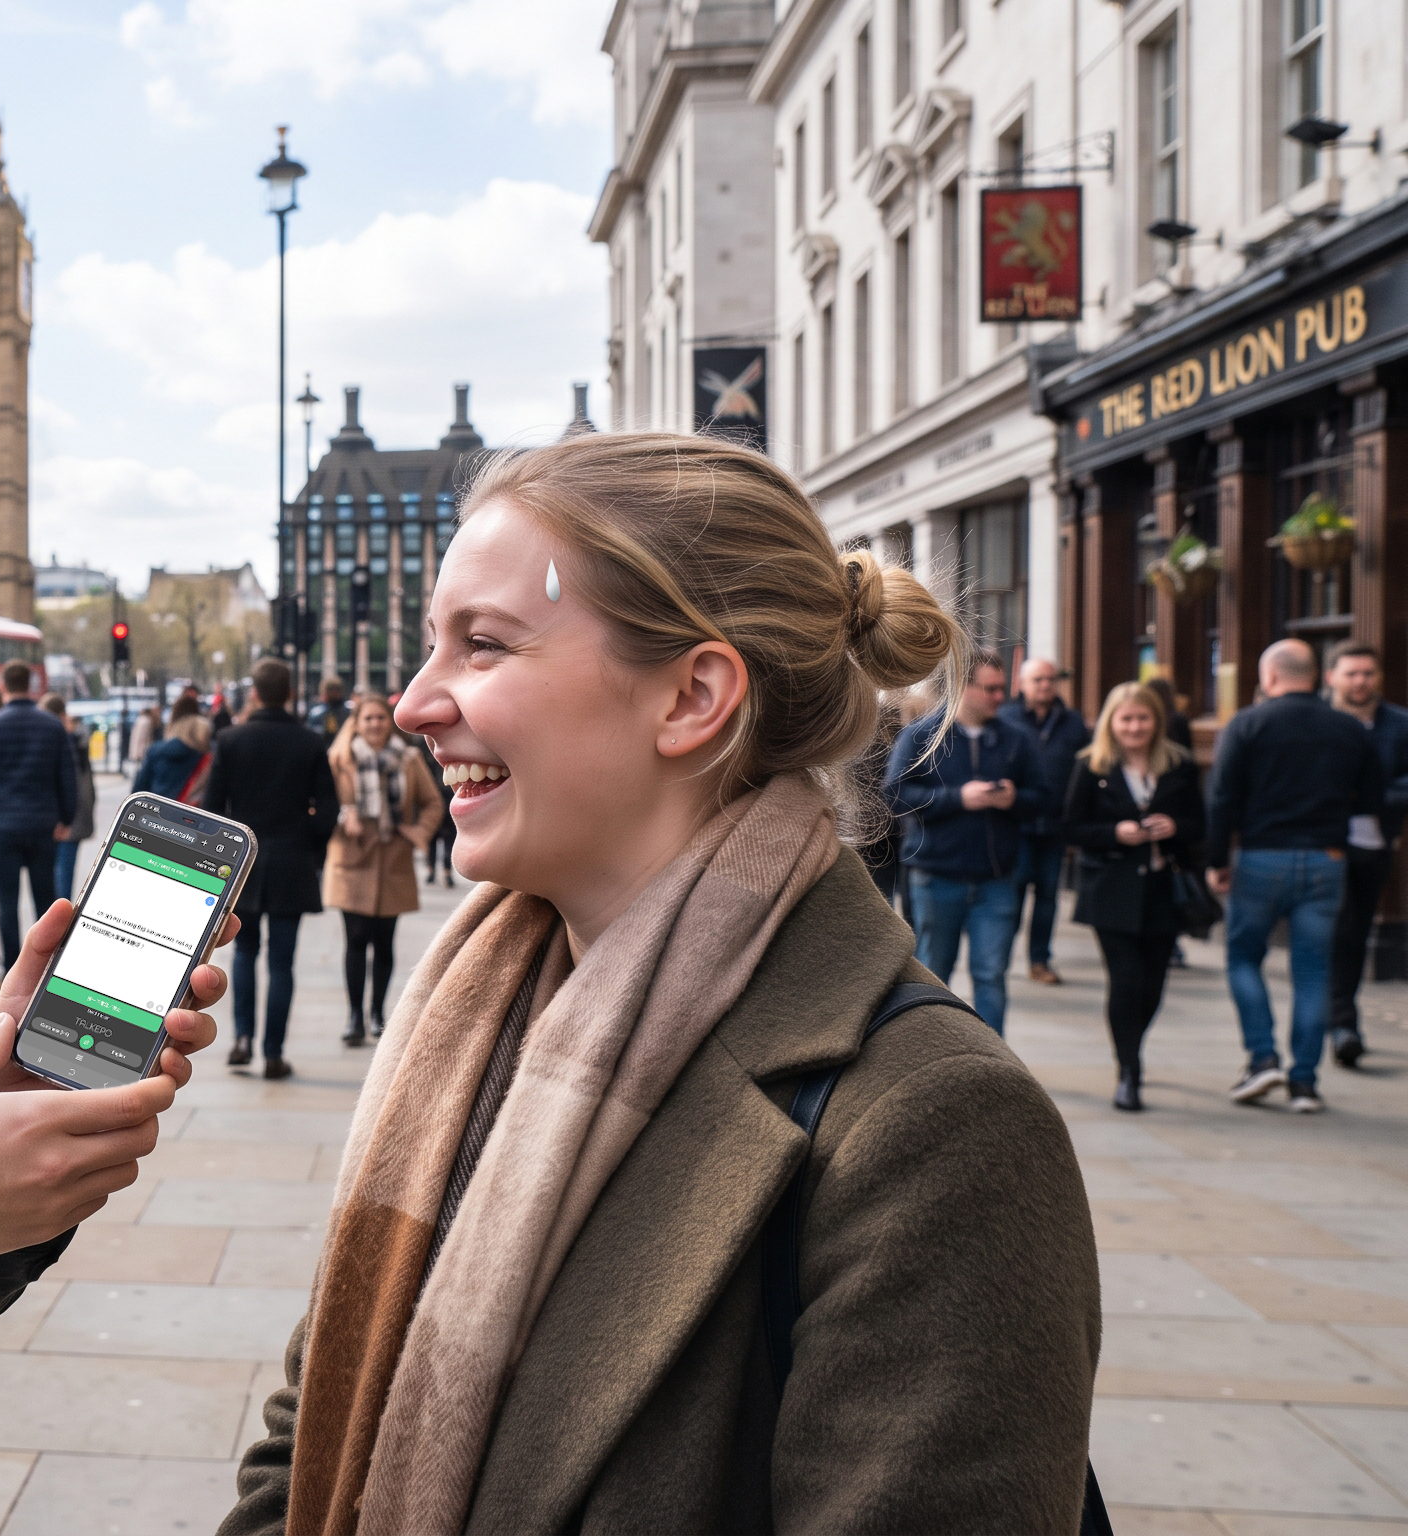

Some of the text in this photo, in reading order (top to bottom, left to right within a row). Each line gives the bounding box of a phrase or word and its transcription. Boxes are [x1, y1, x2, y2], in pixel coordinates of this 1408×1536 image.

[1098, 284, 1368, 438] THE RED LION PUB
[75, 1016, 113, 1038] TALKEPO
